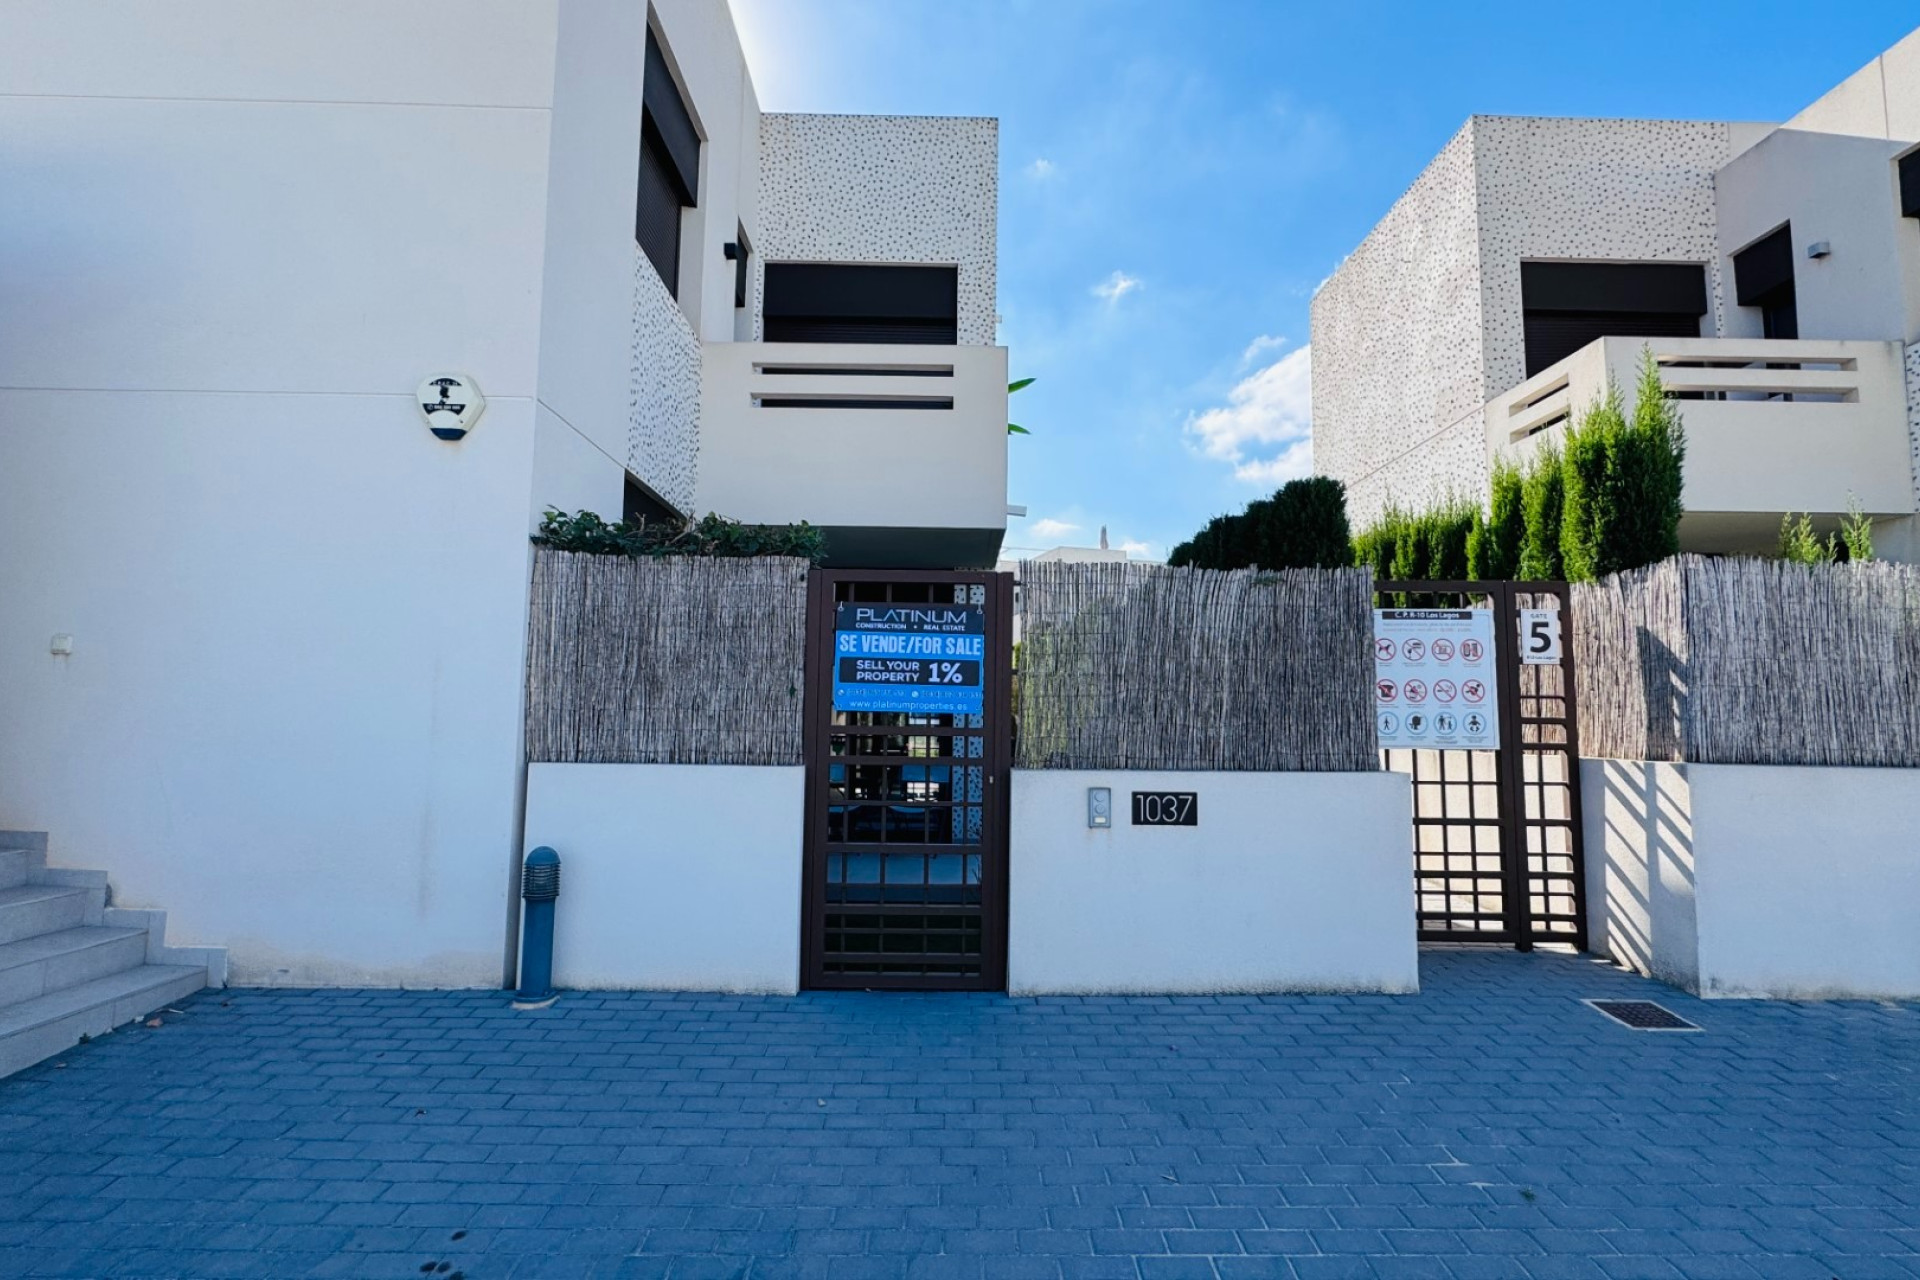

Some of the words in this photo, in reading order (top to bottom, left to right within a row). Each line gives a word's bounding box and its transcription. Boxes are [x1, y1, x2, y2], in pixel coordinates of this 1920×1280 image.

[856, 608, 967, 623] PLATINUM
[855, 622, 907, 630] CONSTRUCTION
[839, 634, 857, 652] SE
[861, 635, 942, 654] VENDE/FOR
[945, 637, 981, 655] SALE
[1530, 621, 1551, 653] 5
[856, 659, 885, 670] SELL
[886, 660, 920, 671] YOUR
[928, 662, 963, 684] 1%
[856, 671, 920, 682] PROPERTY
[1136, 795, 1193, 822] 1037
